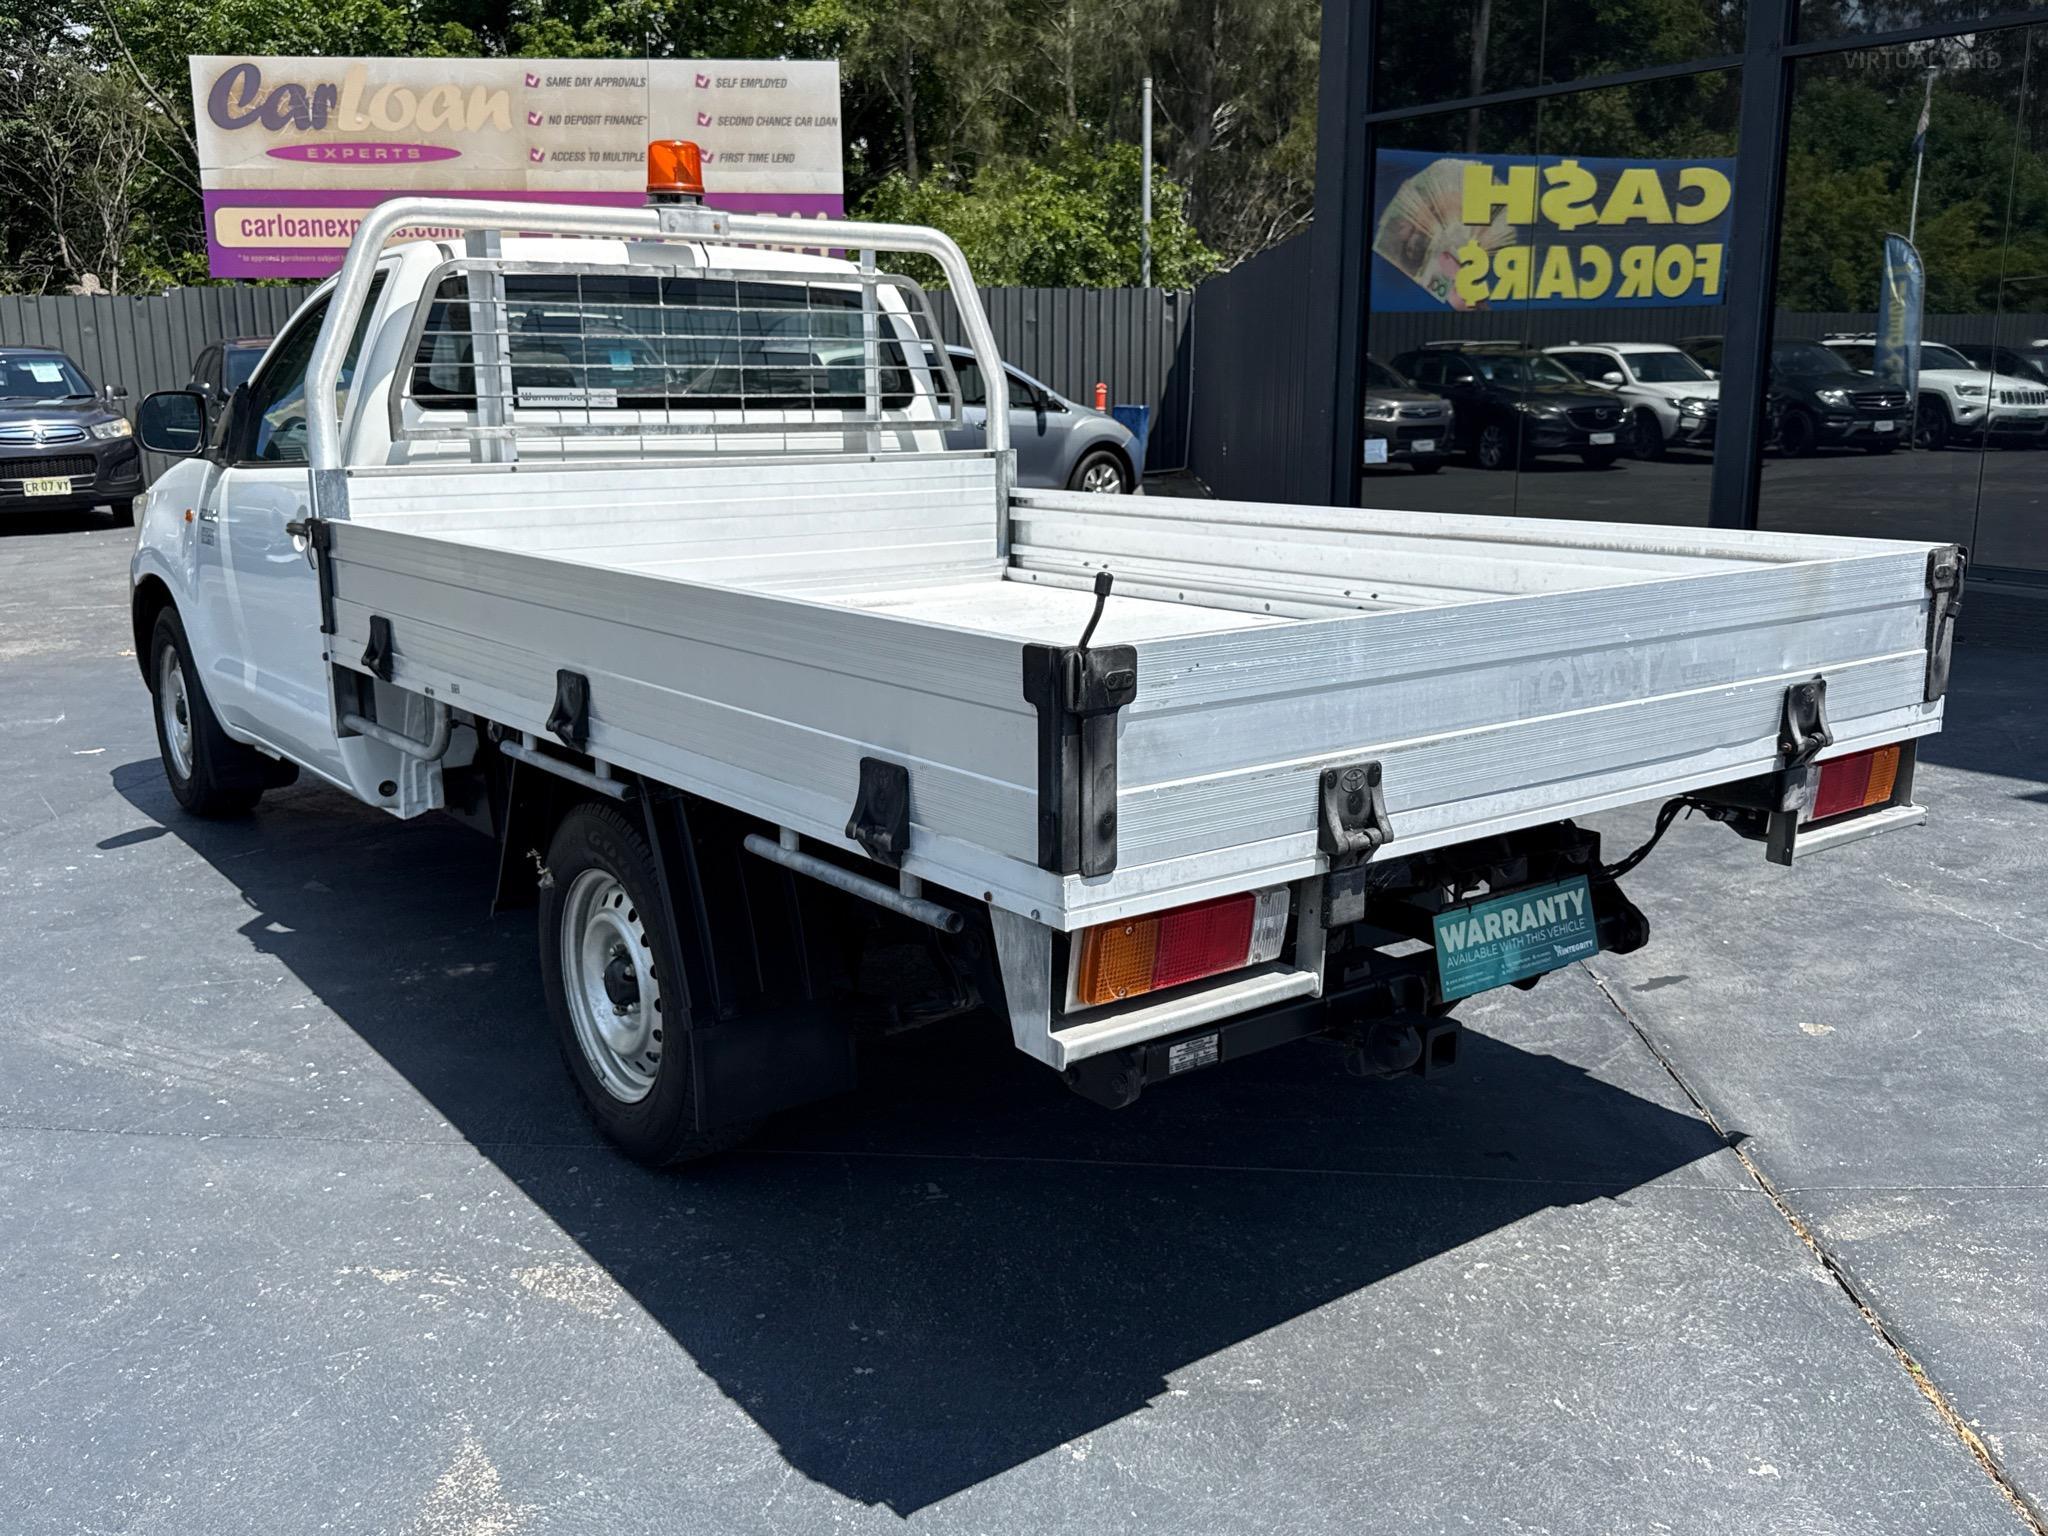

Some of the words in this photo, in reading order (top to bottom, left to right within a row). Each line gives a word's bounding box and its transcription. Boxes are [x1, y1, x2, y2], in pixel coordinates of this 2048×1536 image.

[545, 76, 572, 88] SAME
[574, 76, 592, 88] DAY
[593, 77, 647, 88] APPROVALS
[715, 78, 739, 89] SELF
[740, 78, 788, 89] EMPLOYED
[548, 115, 562, 126] NO
[564, 115, 602, 126] DEPOSIT
[717, 116, 754, 127] SECOND
[756, 116, 792, 127] CHANCE
[794, 117, 813, 127] CAR
[814, 117, 838, 127] LOAN
[306, 148, 422, 160] EXPERTS
[550, 151, 586, 162] ACCESS
[589, 151, 600, 162] TO
[602, 151, 645, 162] MULTIPLE
[719, 153, 744, 164] FIRST
[747, 153, 769, 163] TIME
[1440, 888, 1585, 953] WARRANTY
[1447, 945, 1499, 968] AVAILABLE
[1499, 937, 1525, 953] WITH
[1525, 931, 1547, 945] THIS
[1548, 918, 1586, 938] VEHICLE
